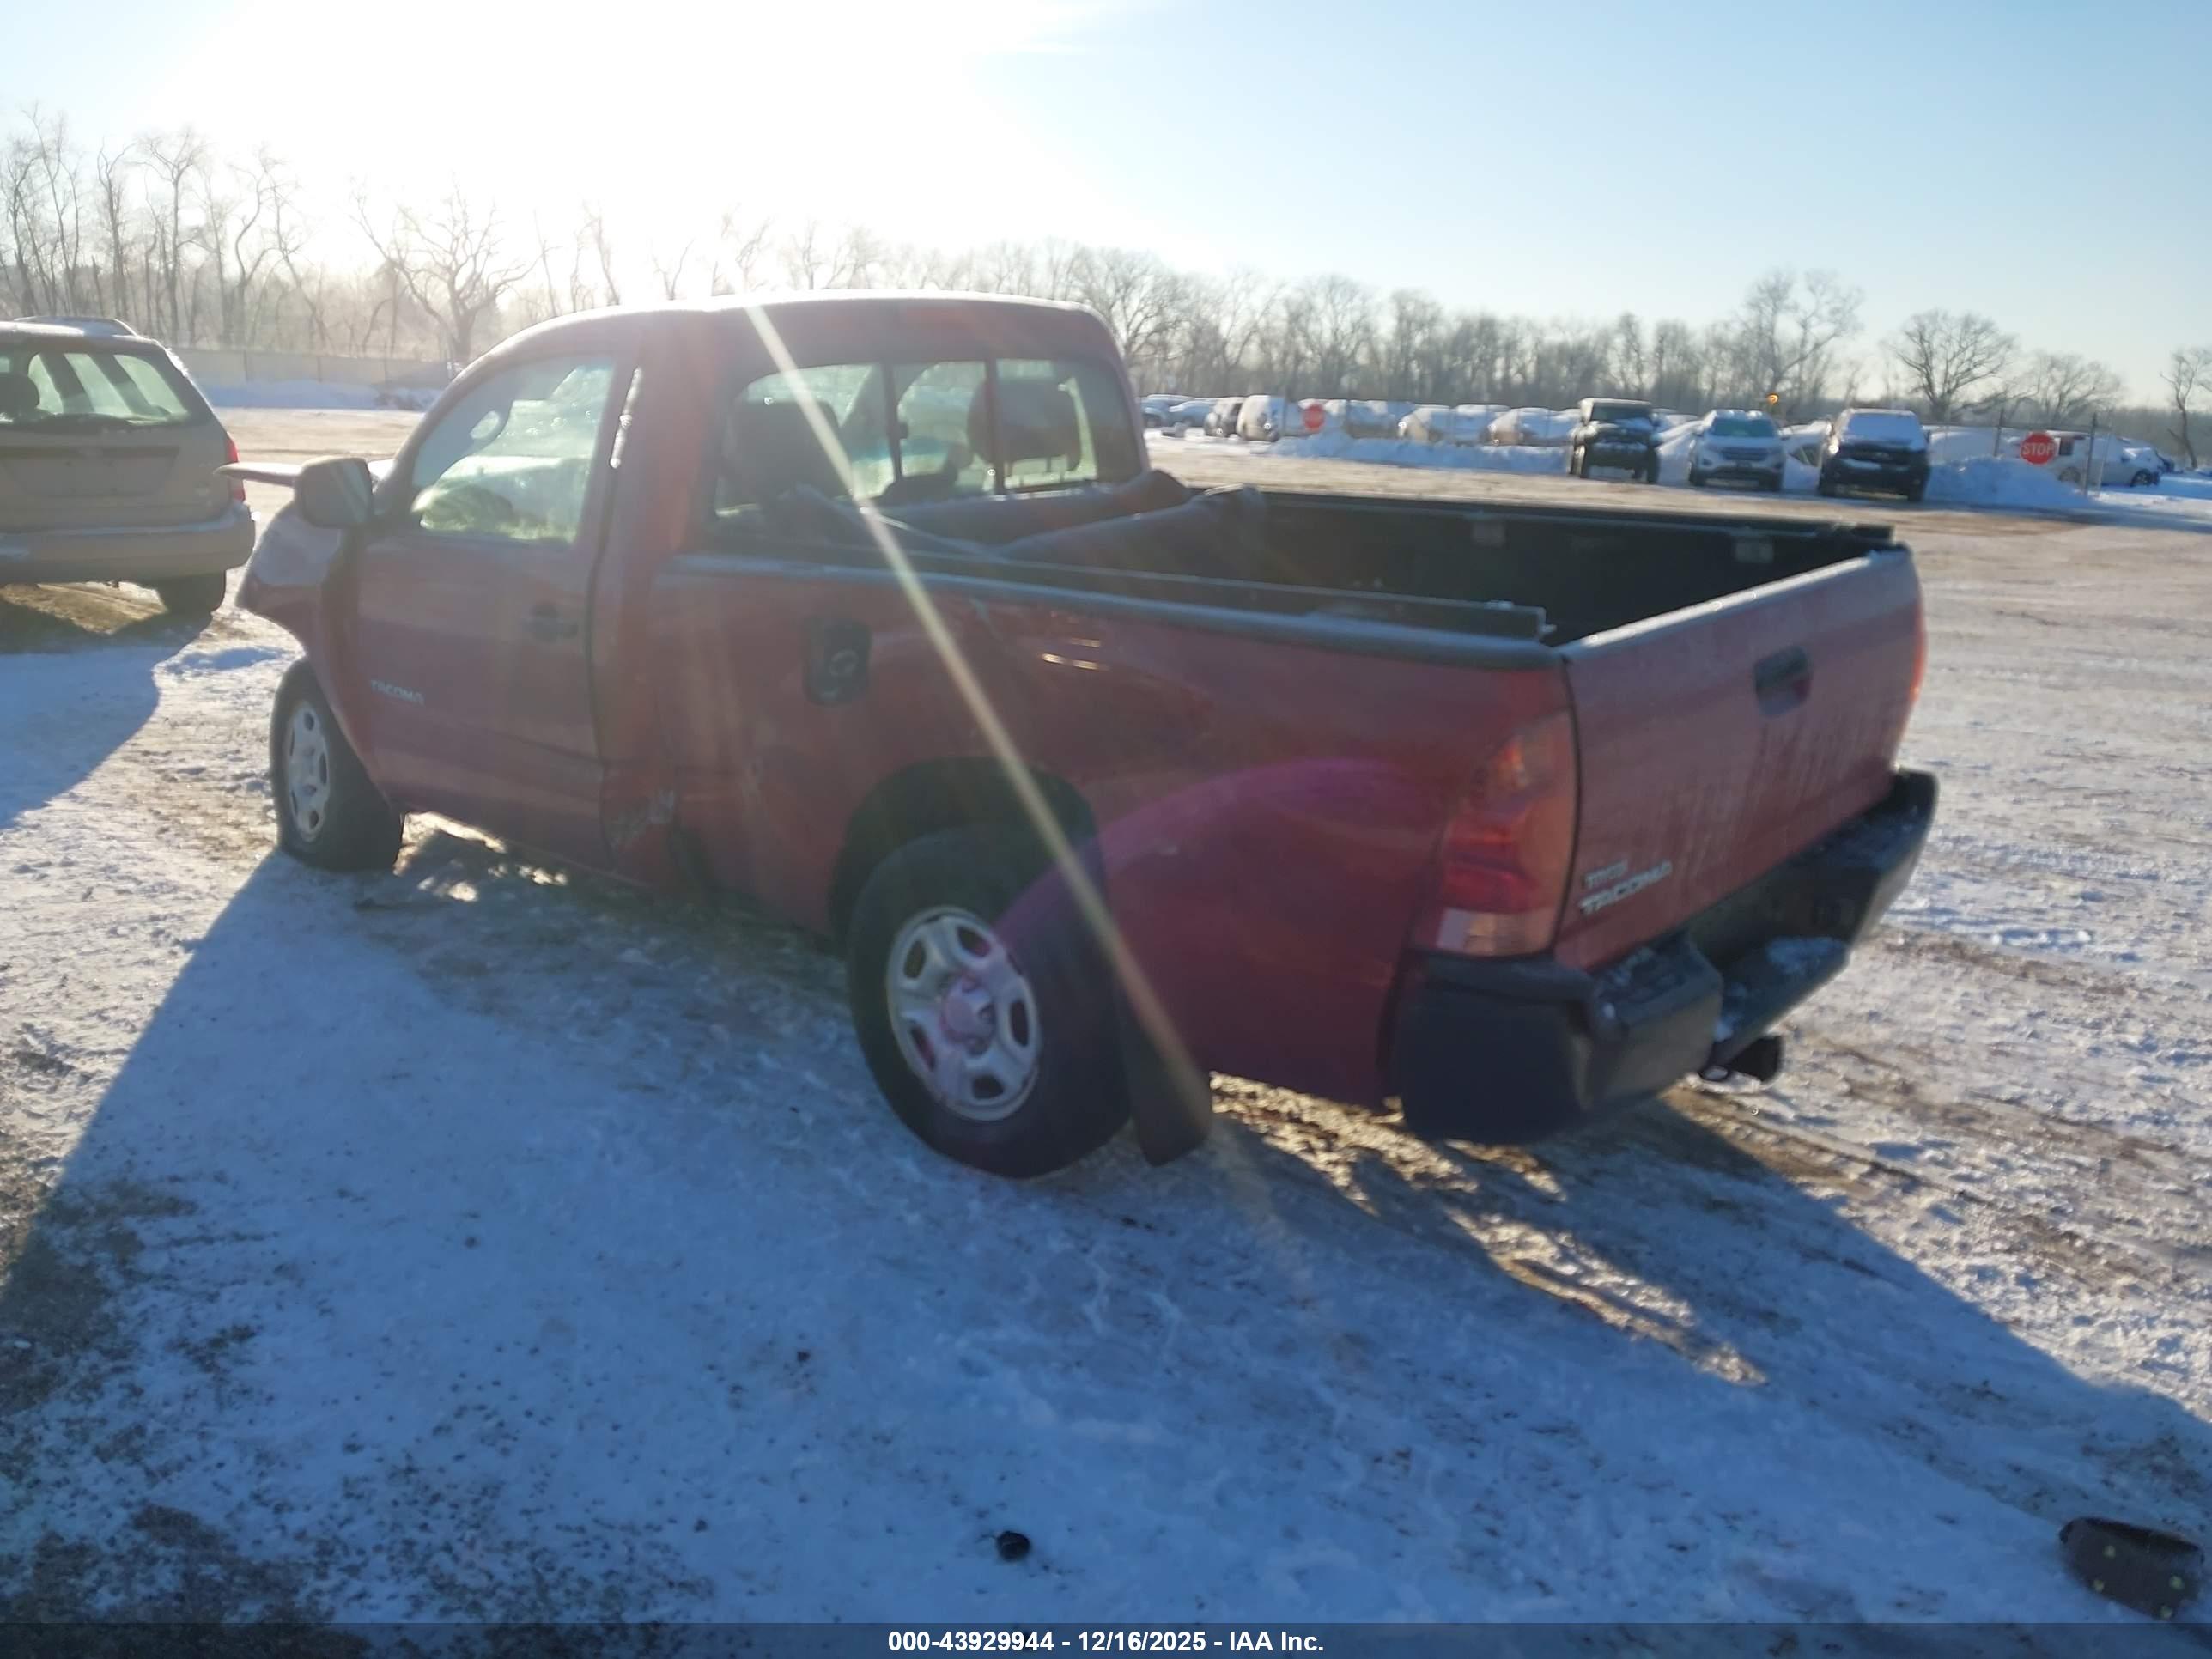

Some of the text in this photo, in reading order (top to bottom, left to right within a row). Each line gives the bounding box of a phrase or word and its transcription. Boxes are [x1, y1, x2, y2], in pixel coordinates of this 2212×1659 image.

[2021, 442, 2055, 455] STOP
[370, 679, 425, 707] TACOMA
[1579, 860, 1672, 915] TACOMA
